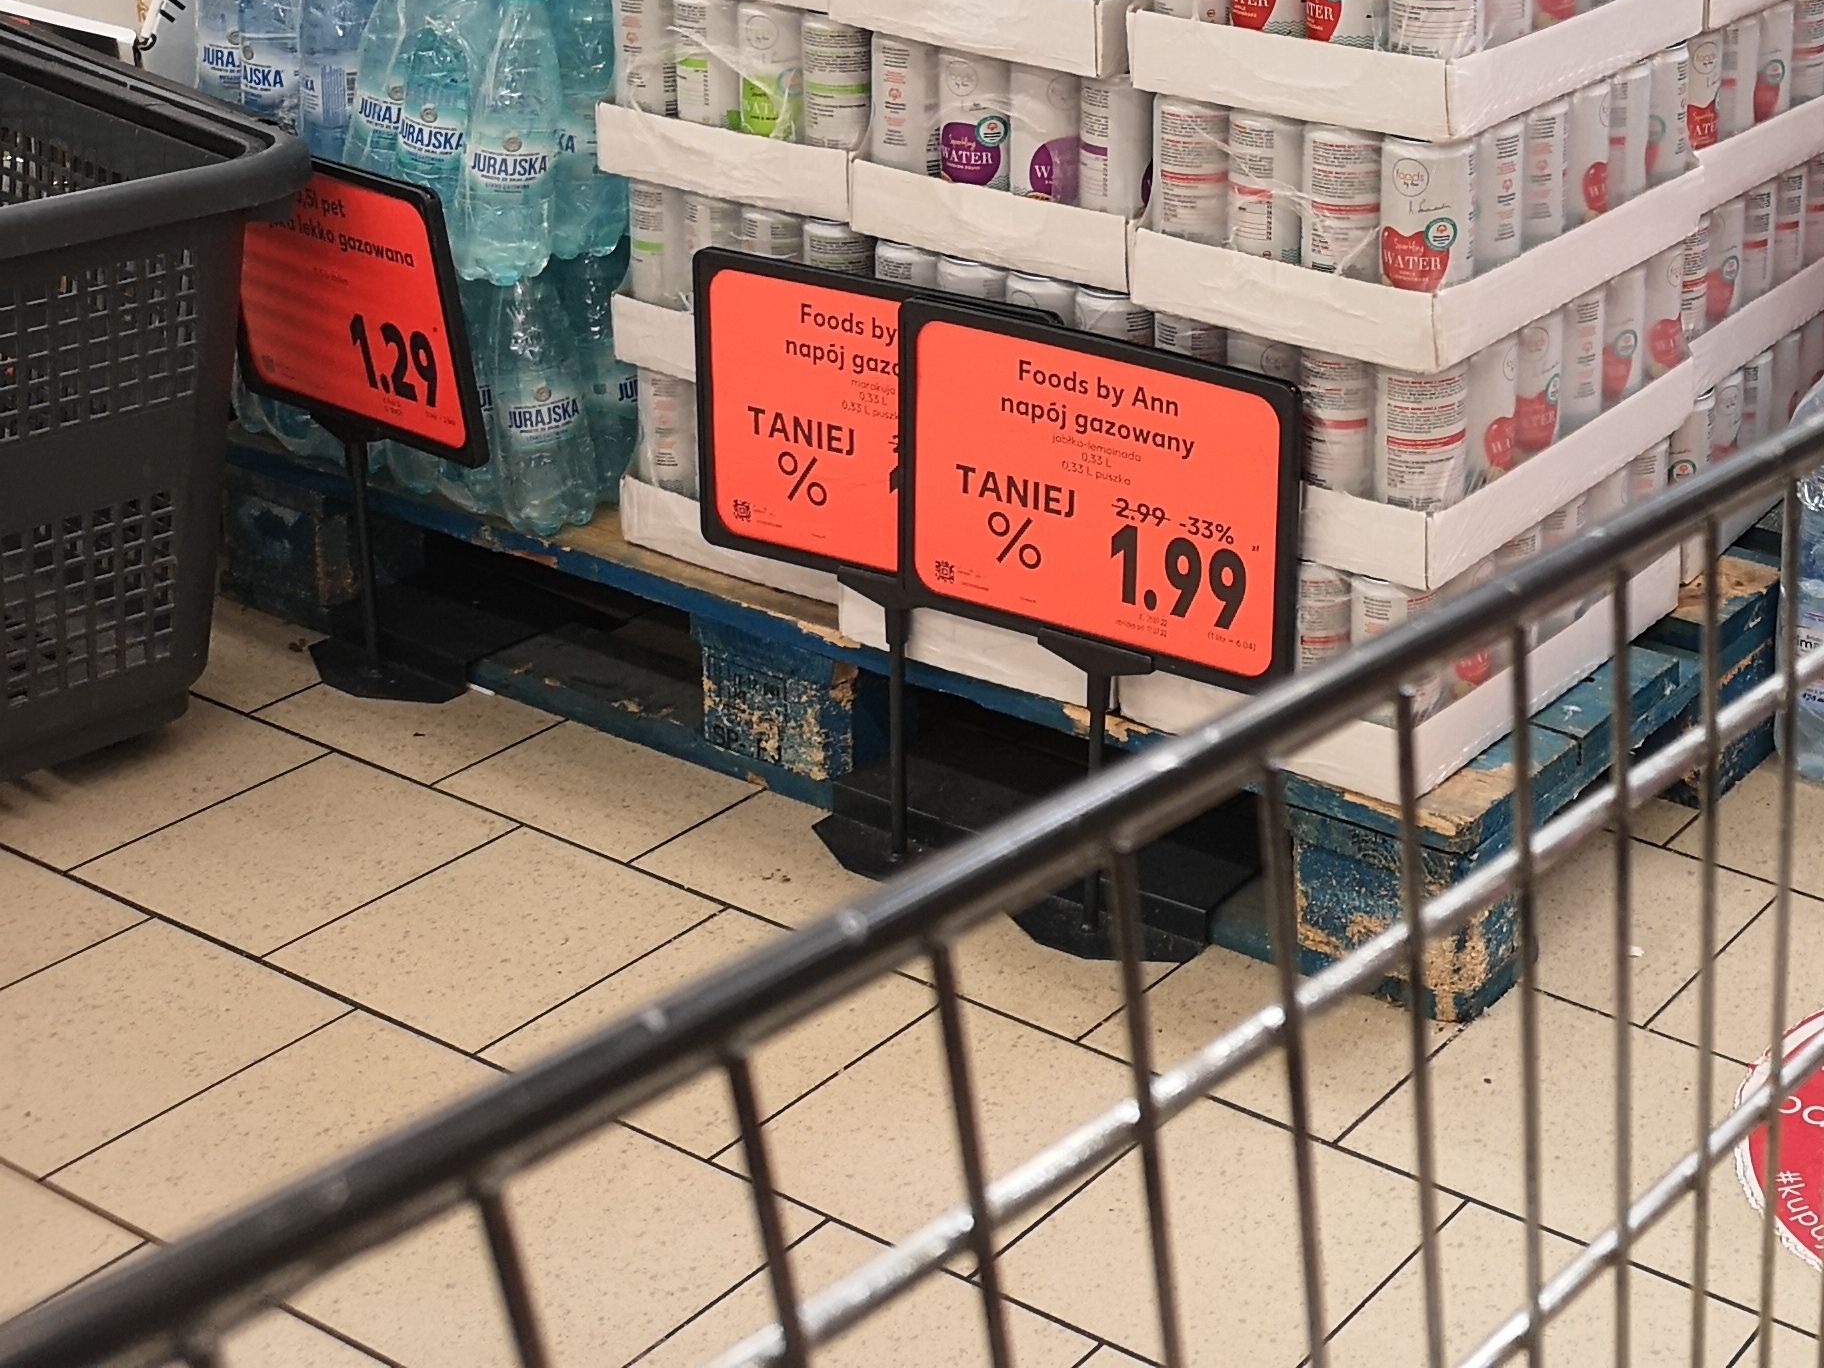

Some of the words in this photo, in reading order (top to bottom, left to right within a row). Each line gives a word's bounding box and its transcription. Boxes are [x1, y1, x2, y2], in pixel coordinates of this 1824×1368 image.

[471, 152, 549, 177] JURAJSKA
[321, 198, 345, 218] pet
[338, 233, 415, 268] gazowana
[1383, 254, 1443, 272] WATER
[800, 303, 865, 336] Foods
[871, 307, 898, 347] by
[349, 312, 438, 408] 1.29
[784, 335, 846, 372] napój
[507, 398, 580, 430] JURAJSKA
[1017, 359, 1090, 400] Foods
[1095, 371, 1126, 408] by
[1131, 385, 1180, 419] Ann
[747, 405, 857, 457] TANIEJ
[1000, 394, 1069, 432] napój
[1074, 411, 1197, 460] gazowany
[777, 449, 829, 507] %
[955, 463, 1076, 520] TANIEJ
[987, 510, 1043, 571] %
[1113, 497, 1168, 528] 2.99
[1178, 516, 1235, 546] -33%
[1110, 523, 1247, 631] 1.99
